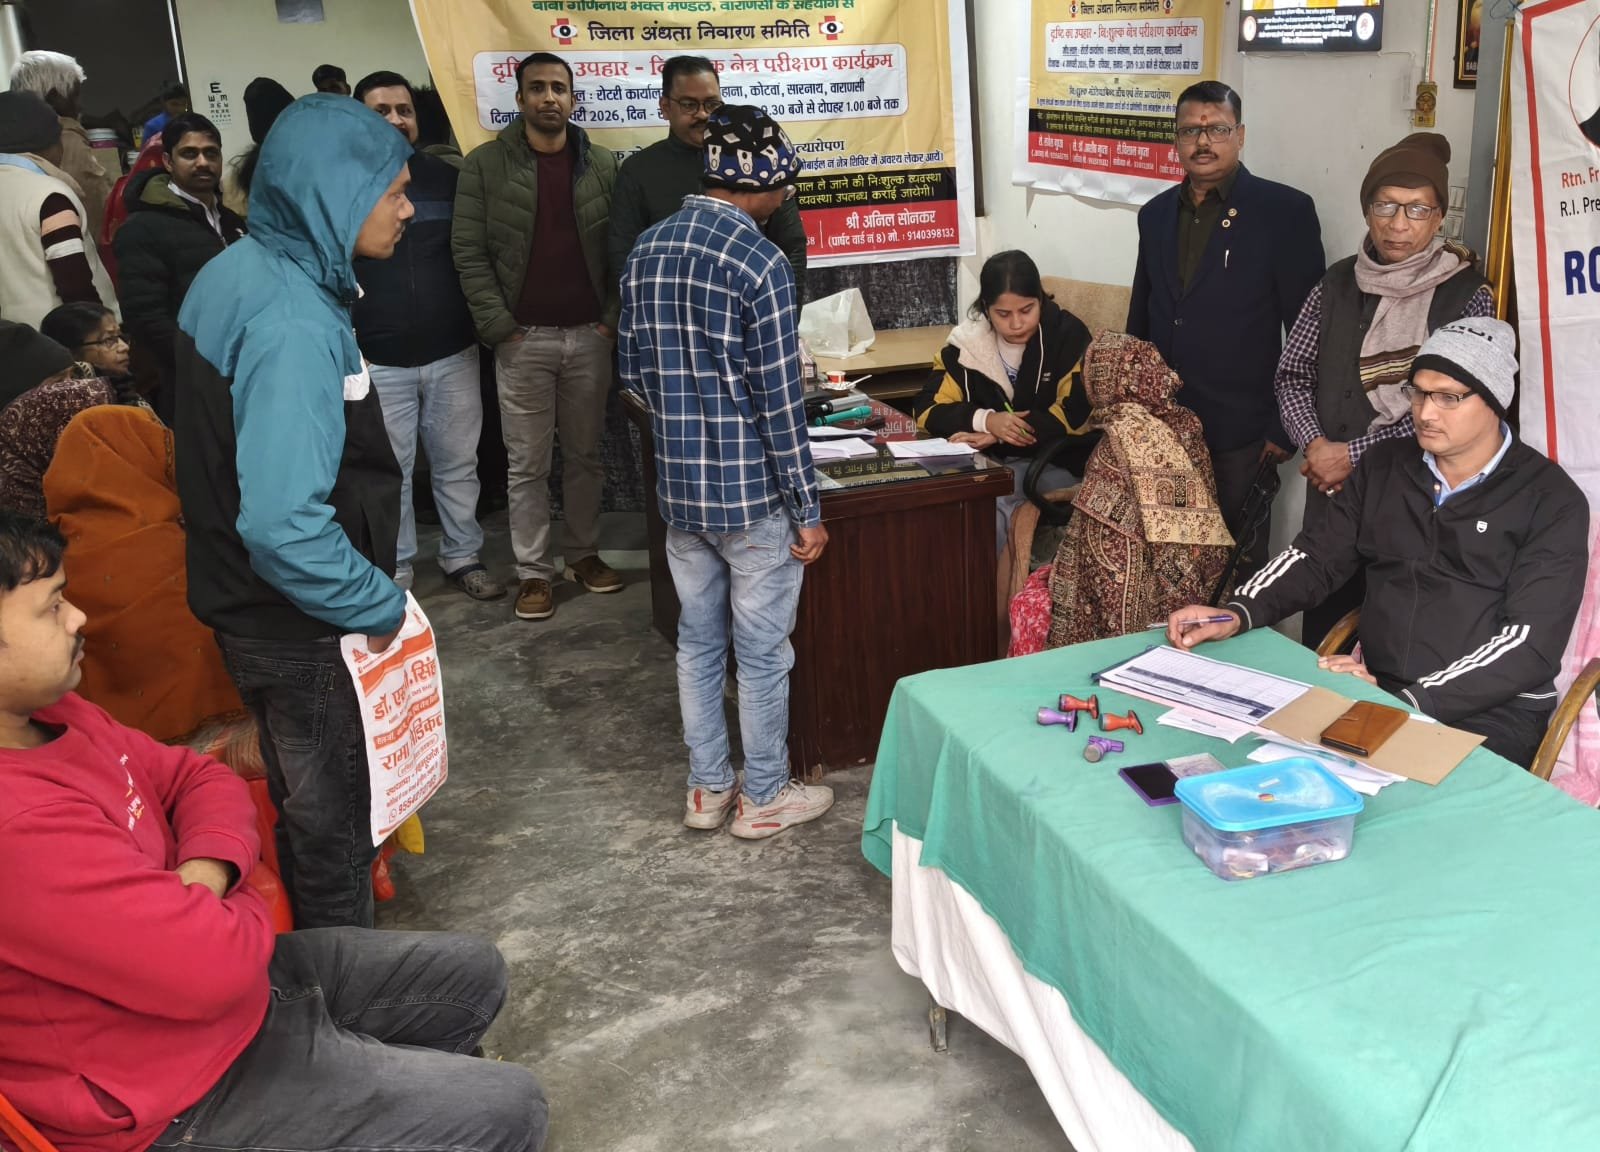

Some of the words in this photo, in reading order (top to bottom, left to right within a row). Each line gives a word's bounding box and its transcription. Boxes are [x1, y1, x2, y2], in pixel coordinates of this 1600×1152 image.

[630, 0, 665, 12] भक्त
[587, 21, 635, 41] जिला
[641, 20, 692, 42] अंधता
[697, 20, 756, 41] निवारण
[760, 18, 810, 40] समिति
[574, 61, 629, 78] उपहार
[729, 53, 759, 74] नेत्र
[763, 52, 828, 73] परीक्षण
[832, 49, 894, 71] कार्यक्रम
[596, 85, 623, 101] रोटरी
[625, 84, 663, 101] कार्याल
[786, 82, 828, 97] सारनाथ,
[830, 77, 865, 94] वाराणसी
[590, 109, 625, 124] 2026,
[627, 105, 647, 121] दिन
[787, 99, 804, 116] बजे
[806, 99, 816, 115] से
[818, 98, 844, 114] दोपहर
[845, 101, 865, 112] 1.00
[867, 95, 882, 111] बजे
[883, 97, 900, 110] तक
[880, 154, 902, 165] अवश्य
[904, 152, 924, 164] लेकर
[817, 178, 826, 190] ले
[829, 175, 849, 189] जाने
[852, 173, 865, 188] की
[908, 172, 942, 185] व्यवस्था
[1561, 171, 1586, 189] Rtn.
[799, 195, 833, 207] व्यवस्था
[836, 190, 868, 204] उपलब्ध
[871, 185, 897, 201] कराई
[846, 211, 860, 230] श्री
[862, 209, 895, 229] अनिल
[897, 208, 936, 226] सोनकर
[1560, 199, 1580, 217] R.I.
